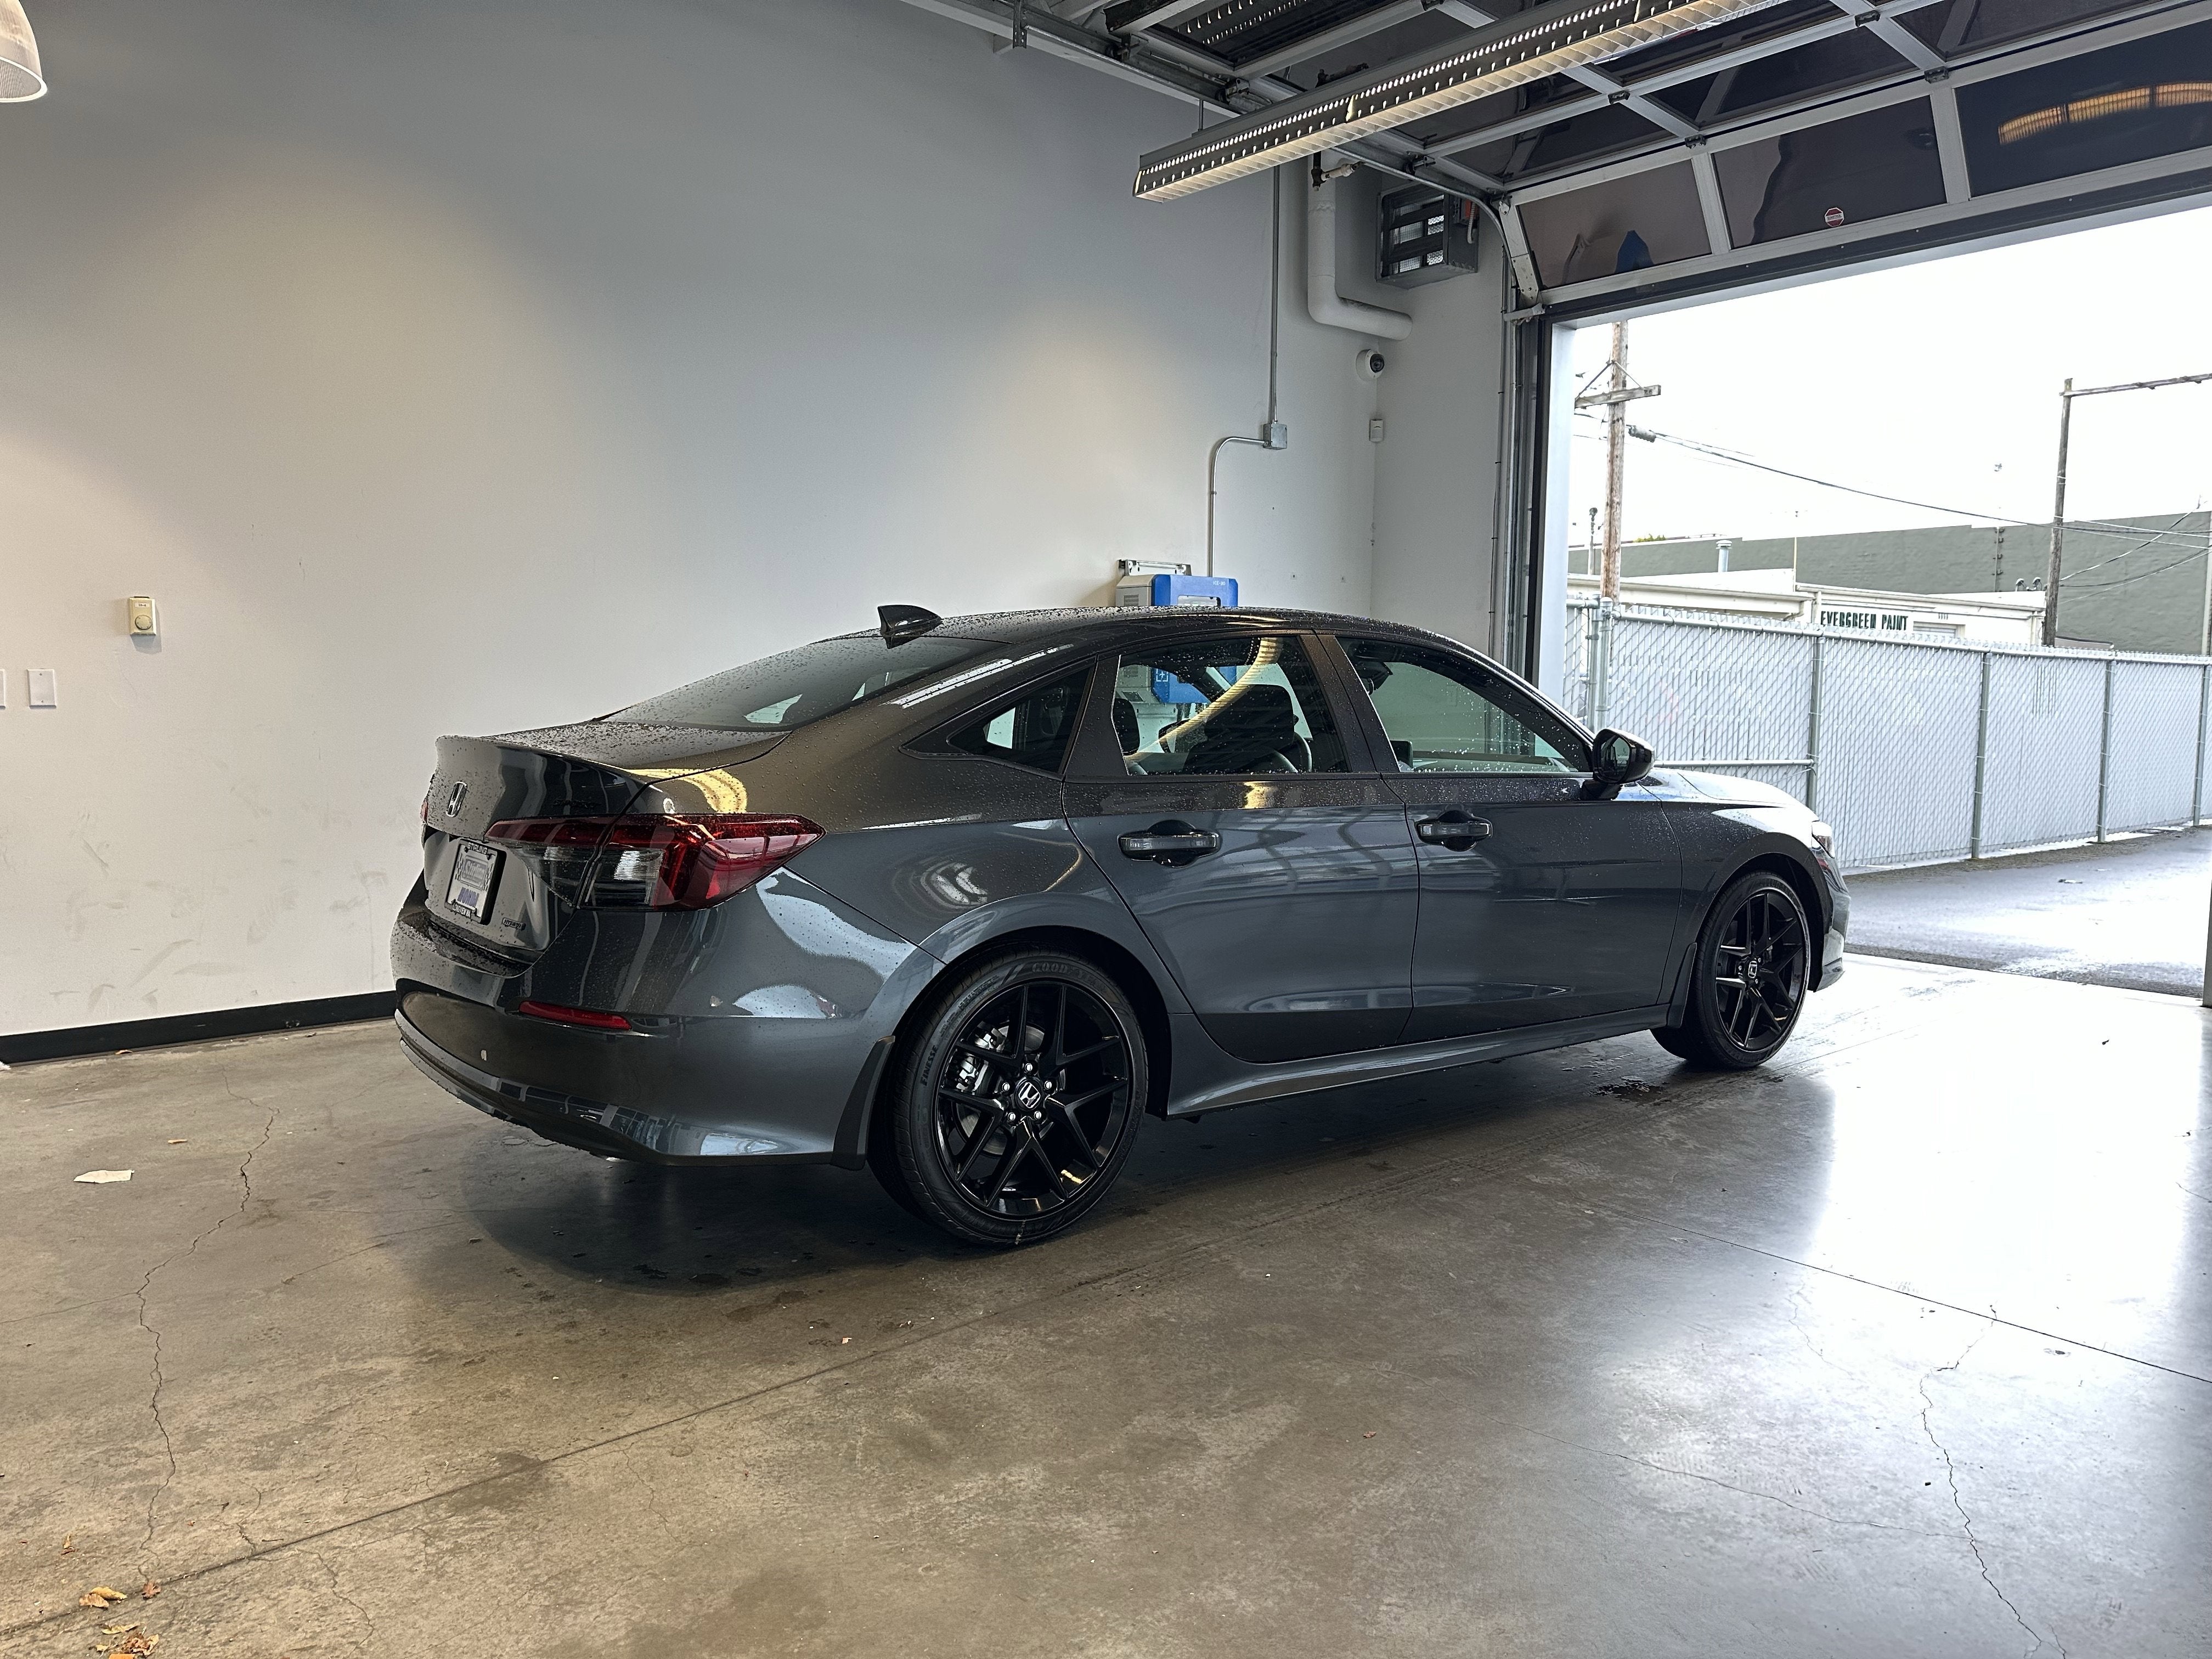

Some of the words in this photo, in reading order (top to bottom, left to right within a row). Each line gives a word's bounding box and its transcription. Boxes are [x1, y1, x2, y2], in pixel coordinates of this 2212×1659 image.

[1820, 611, 1876, 629] EVERGREEN
[1882, 614, 1909, 631] PAINT
[467, 842, 488, 855] STIRLING
[920, 1045, 939, 1086] FINESSE
